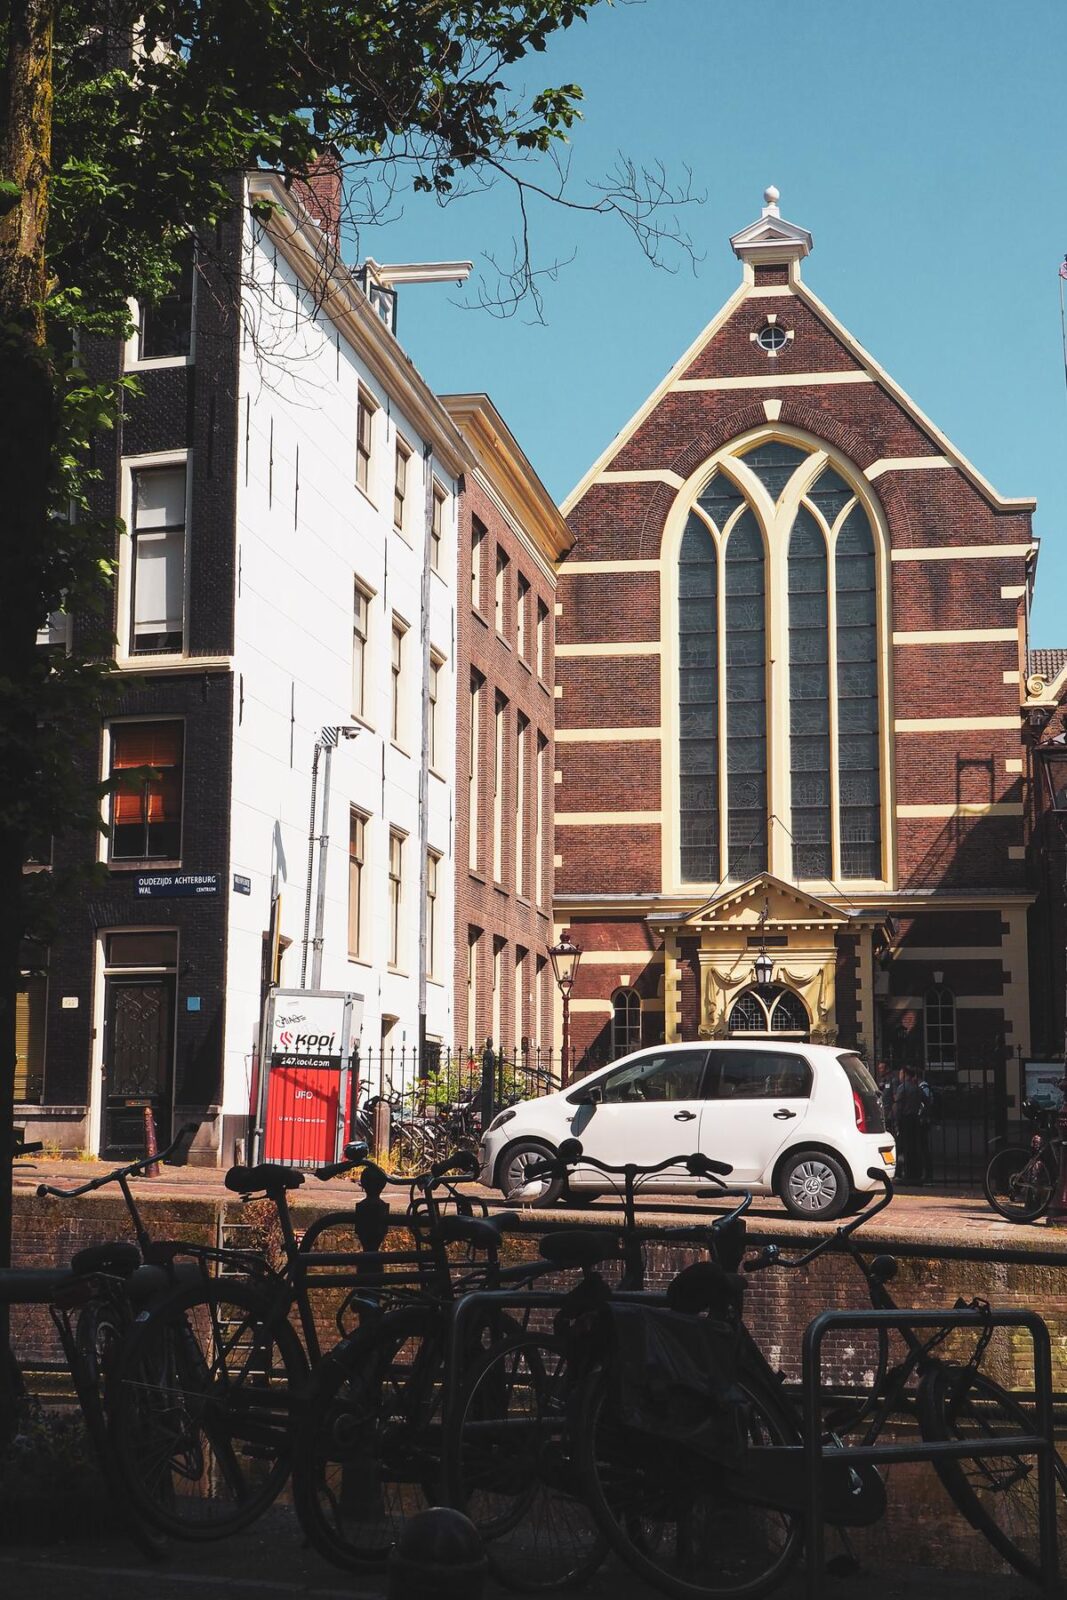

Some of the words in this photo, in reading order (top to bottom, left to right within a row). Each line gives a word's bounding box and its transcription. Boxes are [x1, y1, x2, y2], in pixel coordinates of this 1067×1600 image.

[138, 878, 172, 886] OUDEZIJDS
[174, 876, 216, 885] ACHTERBURG
[138, 887, 152, 895] WAL
[295, 1091, 313, 1100] UFO
